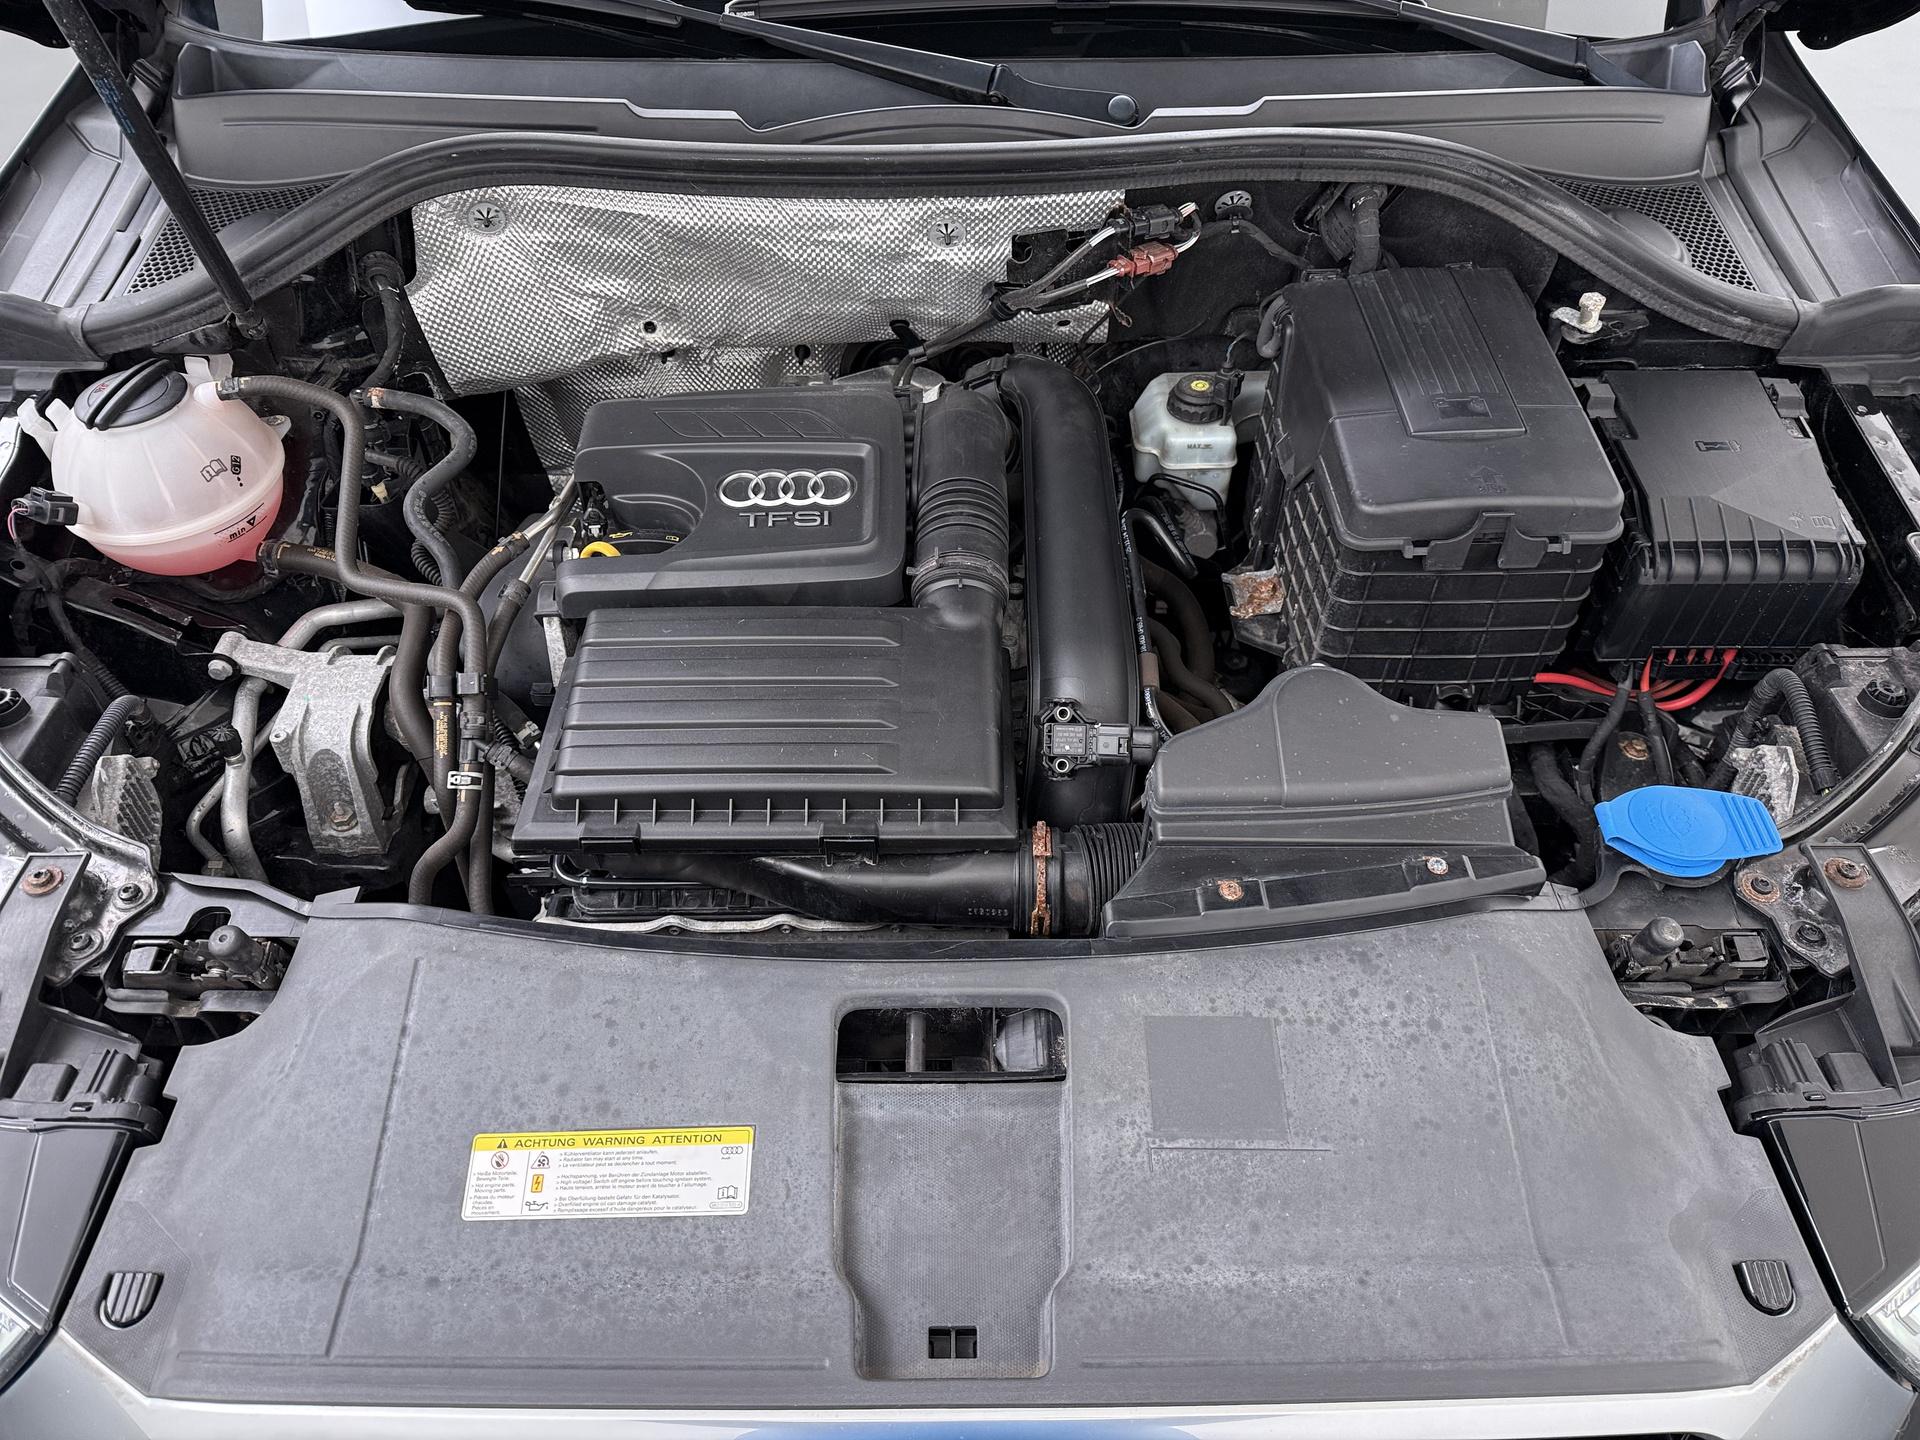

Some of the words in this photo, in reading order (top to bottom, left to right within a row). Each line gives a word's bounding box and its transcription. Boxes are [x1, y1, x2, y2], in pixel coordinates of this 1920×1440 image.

[231, 455, 241, 474] G12
[739, 510, 830, 528] TFSI
[229, 526, 246, 541] min
[514, 1137, 576, 1148] ACHTUNG
[582, 1136, 645, 1146] WARNING
[652, 1134, 722, 1144] ATTENTION
